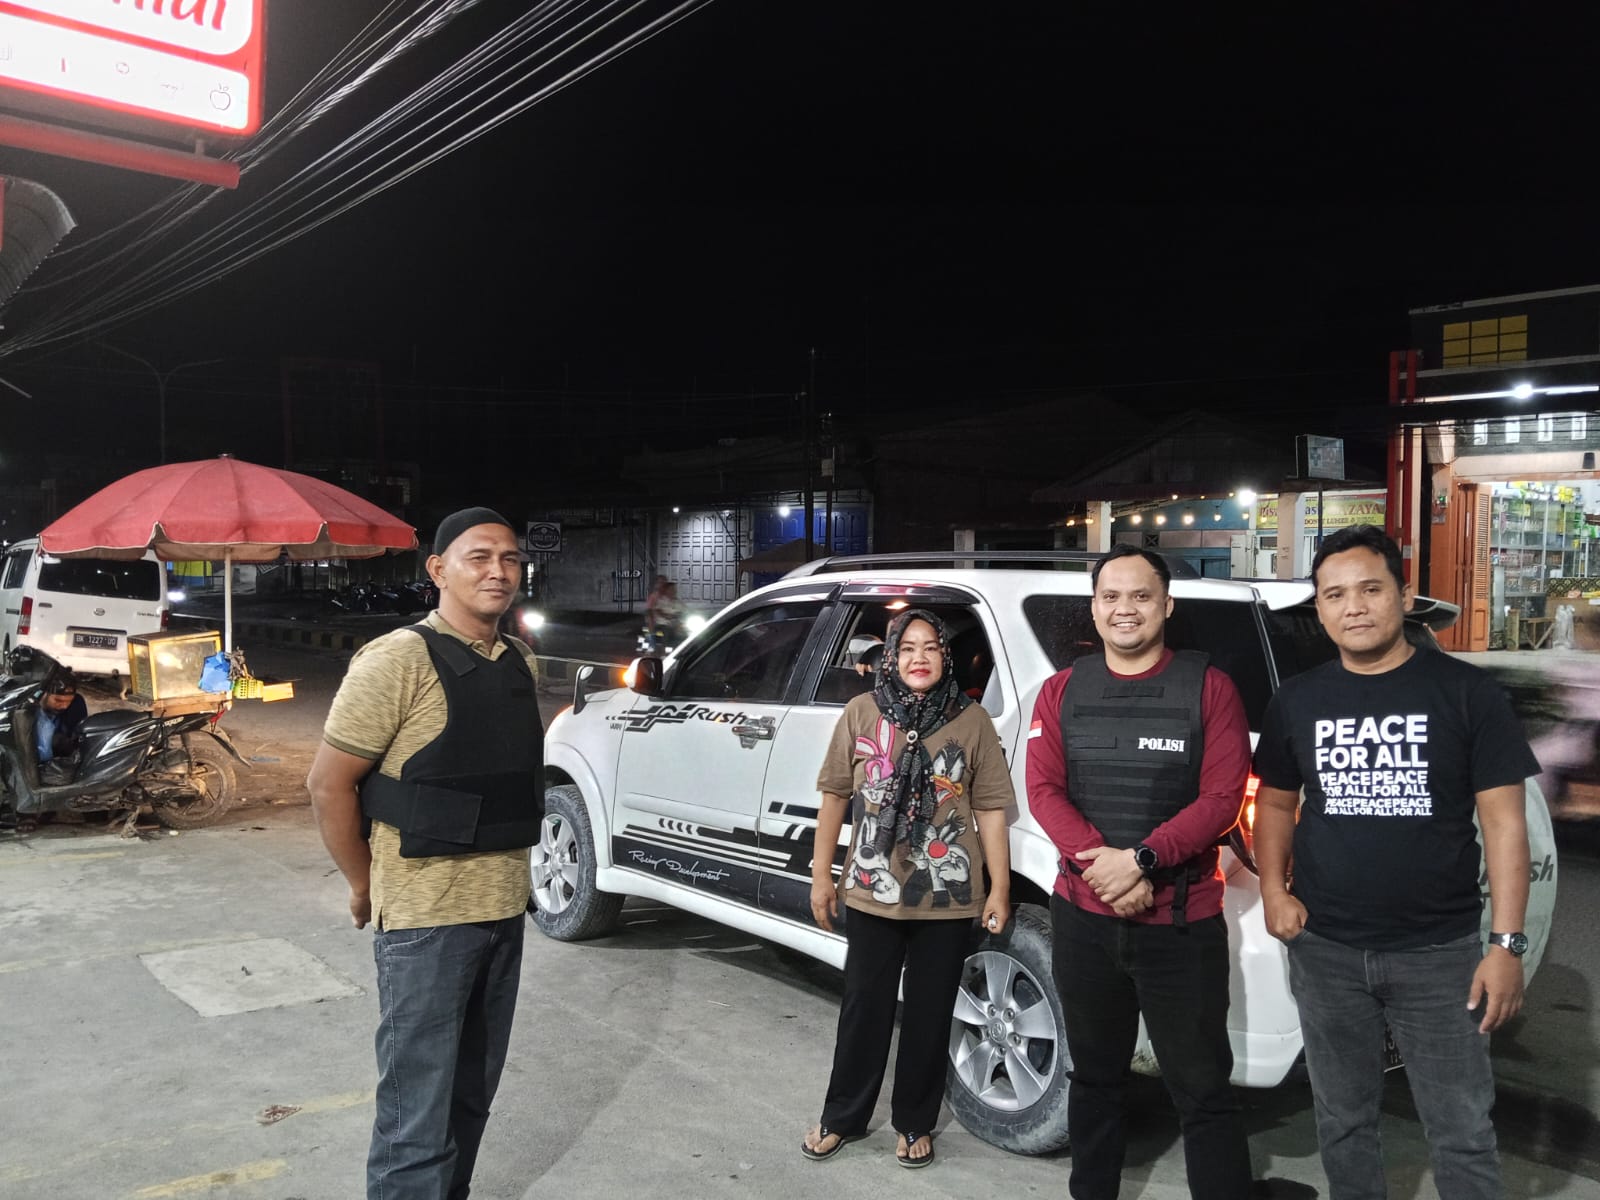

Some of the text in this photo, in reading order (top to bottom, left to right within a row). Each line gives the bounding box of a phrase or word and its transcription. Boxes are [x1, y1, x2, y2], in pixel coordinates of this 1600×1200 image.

[89, 635, 104, 644] 1227
[690, 707, 748, 725] Rush
[1315, 715, 1428, 747] PEACE
[1138, 737, 1185, 752] POLISI
[1315, 744, 1429, 771] FOR ALL
[1319, 770, 1428, 786] PEACE PEACE
[1345, 785, 1371, 797] ALL
[1373, 785, 1400, 797] FOR
[1404, 784, 1430, 796] ALL
[1325, 798, 1432, 808] PEACE PEACE PEACE
[1375, 807, 1392, 816] ALL
[1394, 808, 1413, 816] FOR
[1415, 807, 1433, 816] ALL
